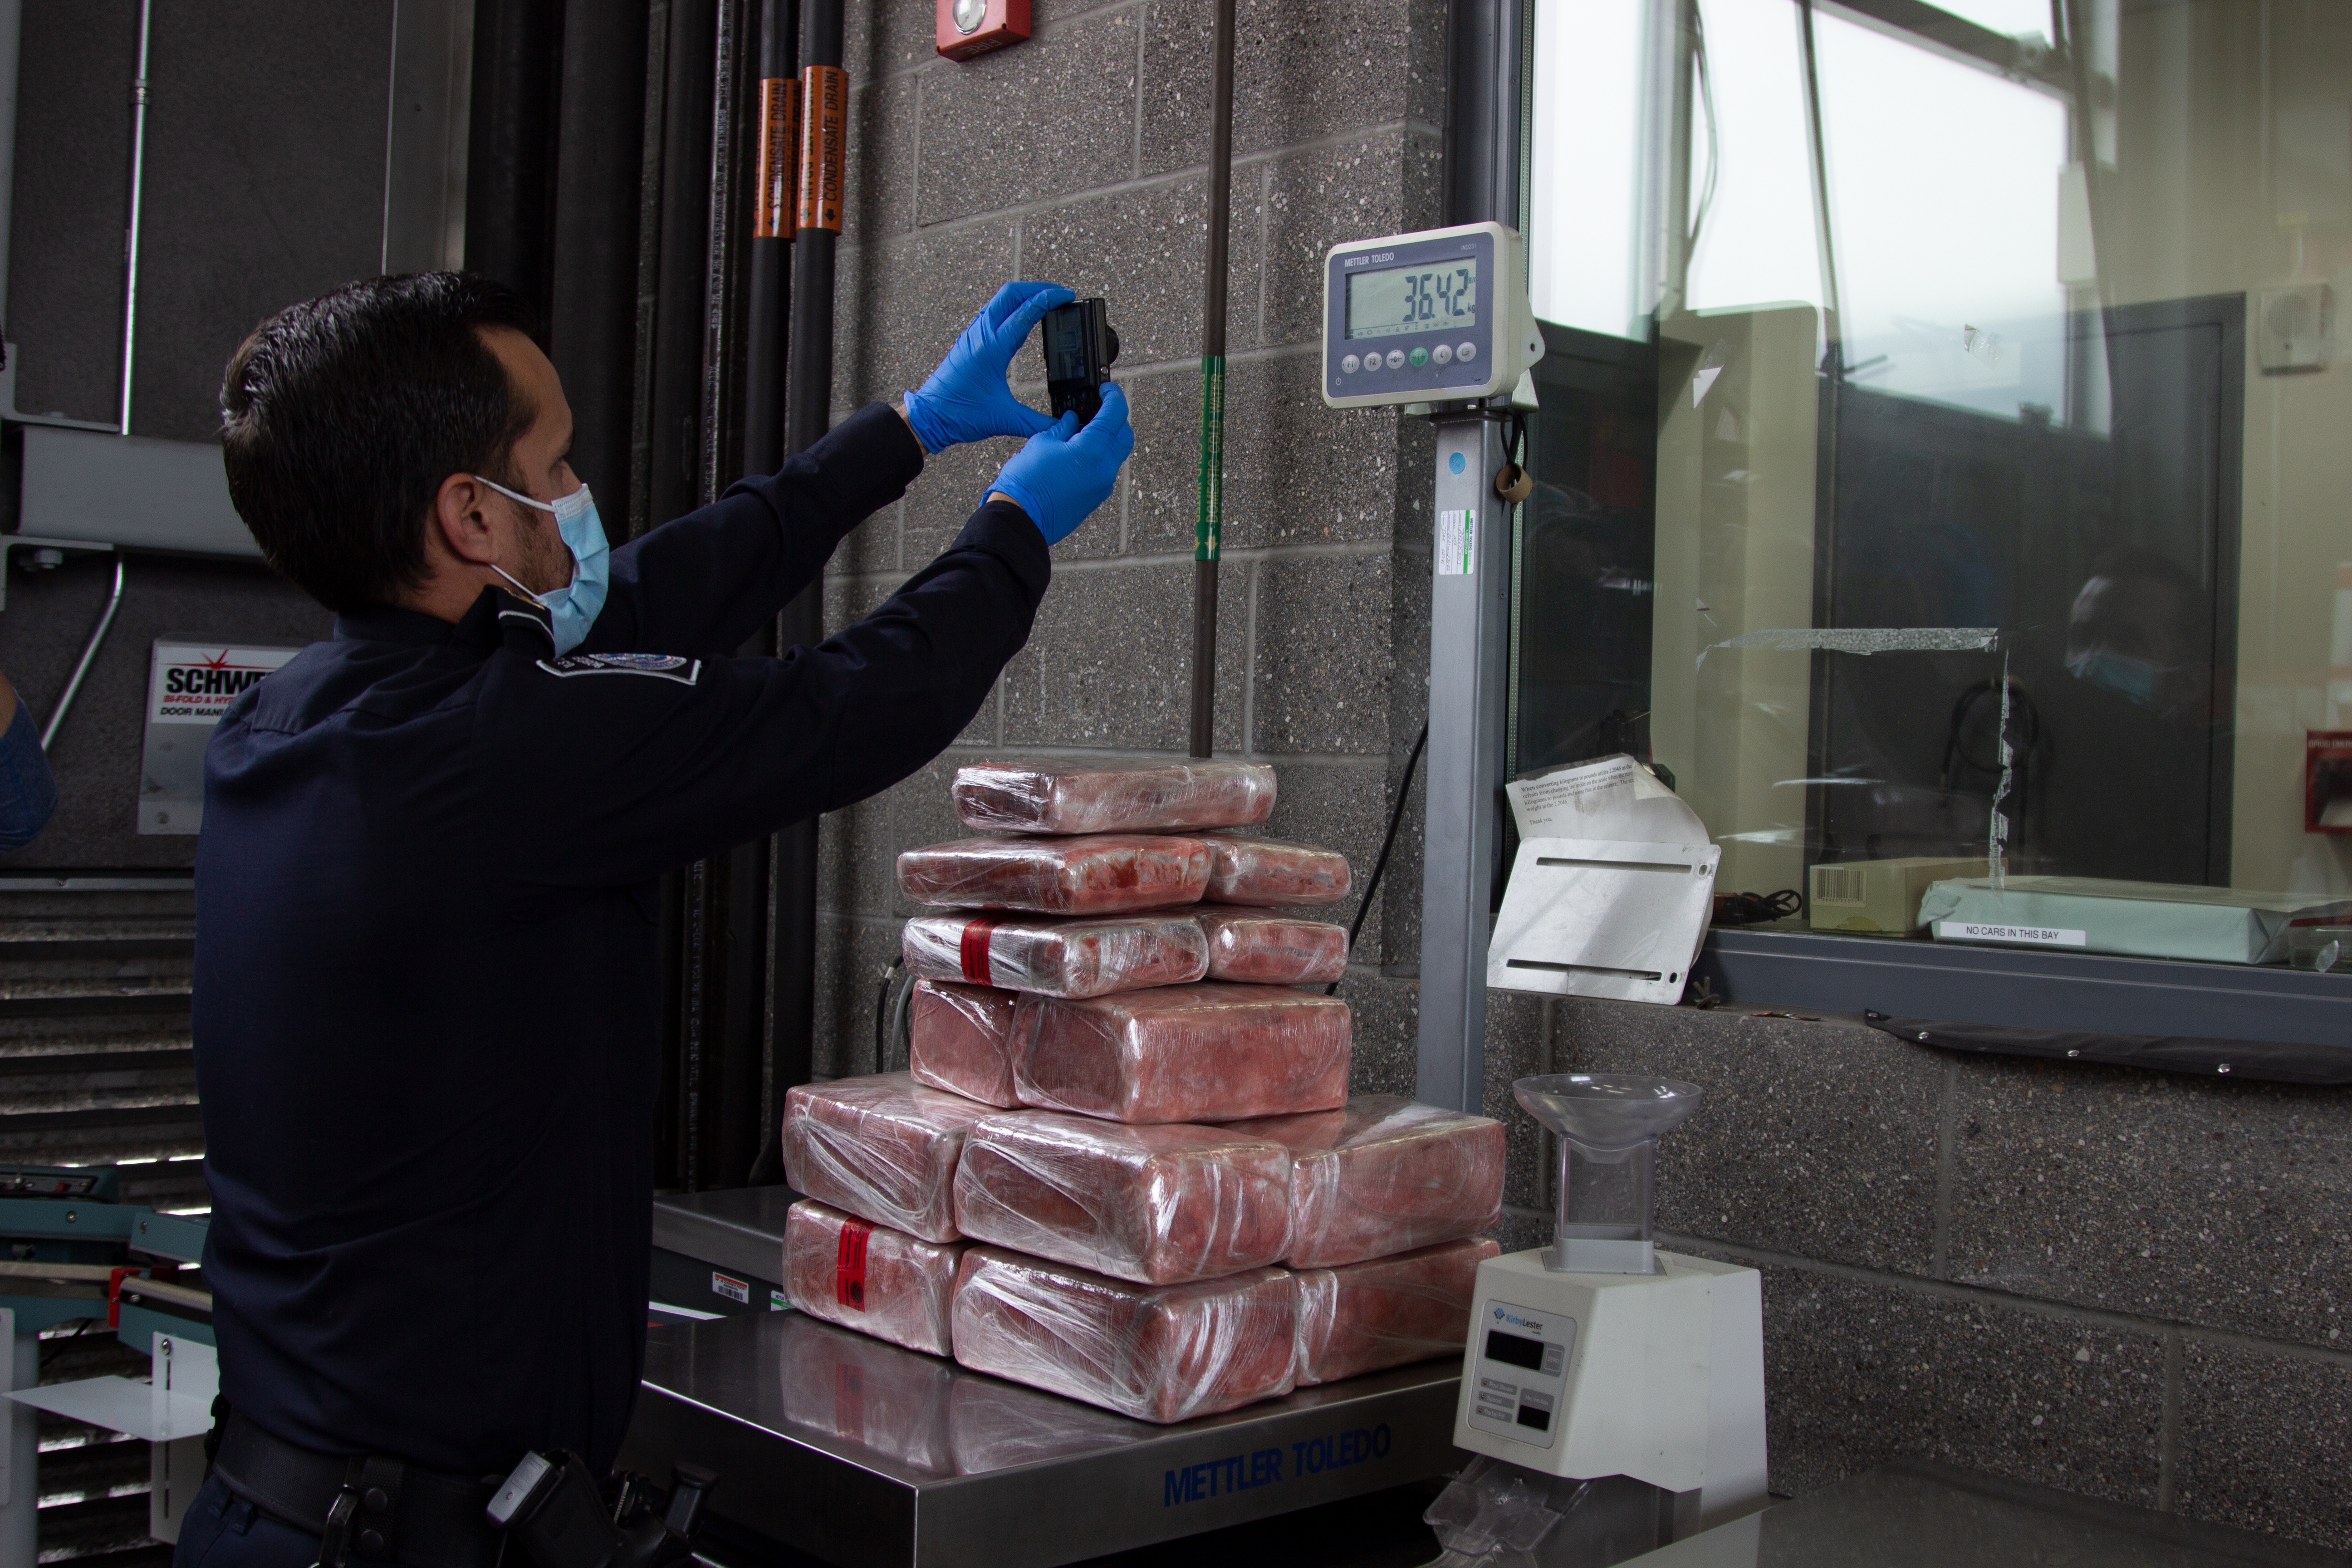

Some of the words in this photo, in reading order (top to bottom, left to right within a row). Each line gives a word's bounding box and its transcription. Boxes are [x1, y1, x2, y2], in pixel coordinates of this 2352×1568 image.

[960, 39, 1003, 55] FIRE
[771, 82, 787, 121] DRAIN
[825, 71, 838, 111] DRAIN
[767, 126, 786, 210] CONDENSATE
[823, 115, 838, 202] CONDENSATE
[1345, 257, 1369, 268] METTLER
[1372, 252, 1395, 263] TOLEDO
[1209, 373, 1223, 414] WATER
[1208, 420, 1221, 454] COLD
[1205, 459, 1220, 523] DOMESTIC
[166, 668, 273, 694] SCHW
[162, 694, 203, 704] BI-FOLD
[204, 696, 212, 704] &
[160, 706, 192, 716] DOOR
[1536, 781, 1559, 789] converting
[1559, 776, 1579, 785] kilograms
[1584, 772, 1597, 780] pounds
[1524, 797, 1547, 805] kilograms
[1966, 926, 1980, 935] NO
[1981, 927, 2005, 936] CARS
[2008, 929, 2017, 937] IN
[2019, 929, 2039, 939] THIS
[2041, 931, 2059, 940] BAY
[1506, 1314, 1543, 1330] KirbyLester
[1486, 1396, 1502, 1405] Special
[1164, 1448, 1283, 1507] METTLER
[1292, 1423, 1392, 1477] TOLEDO
